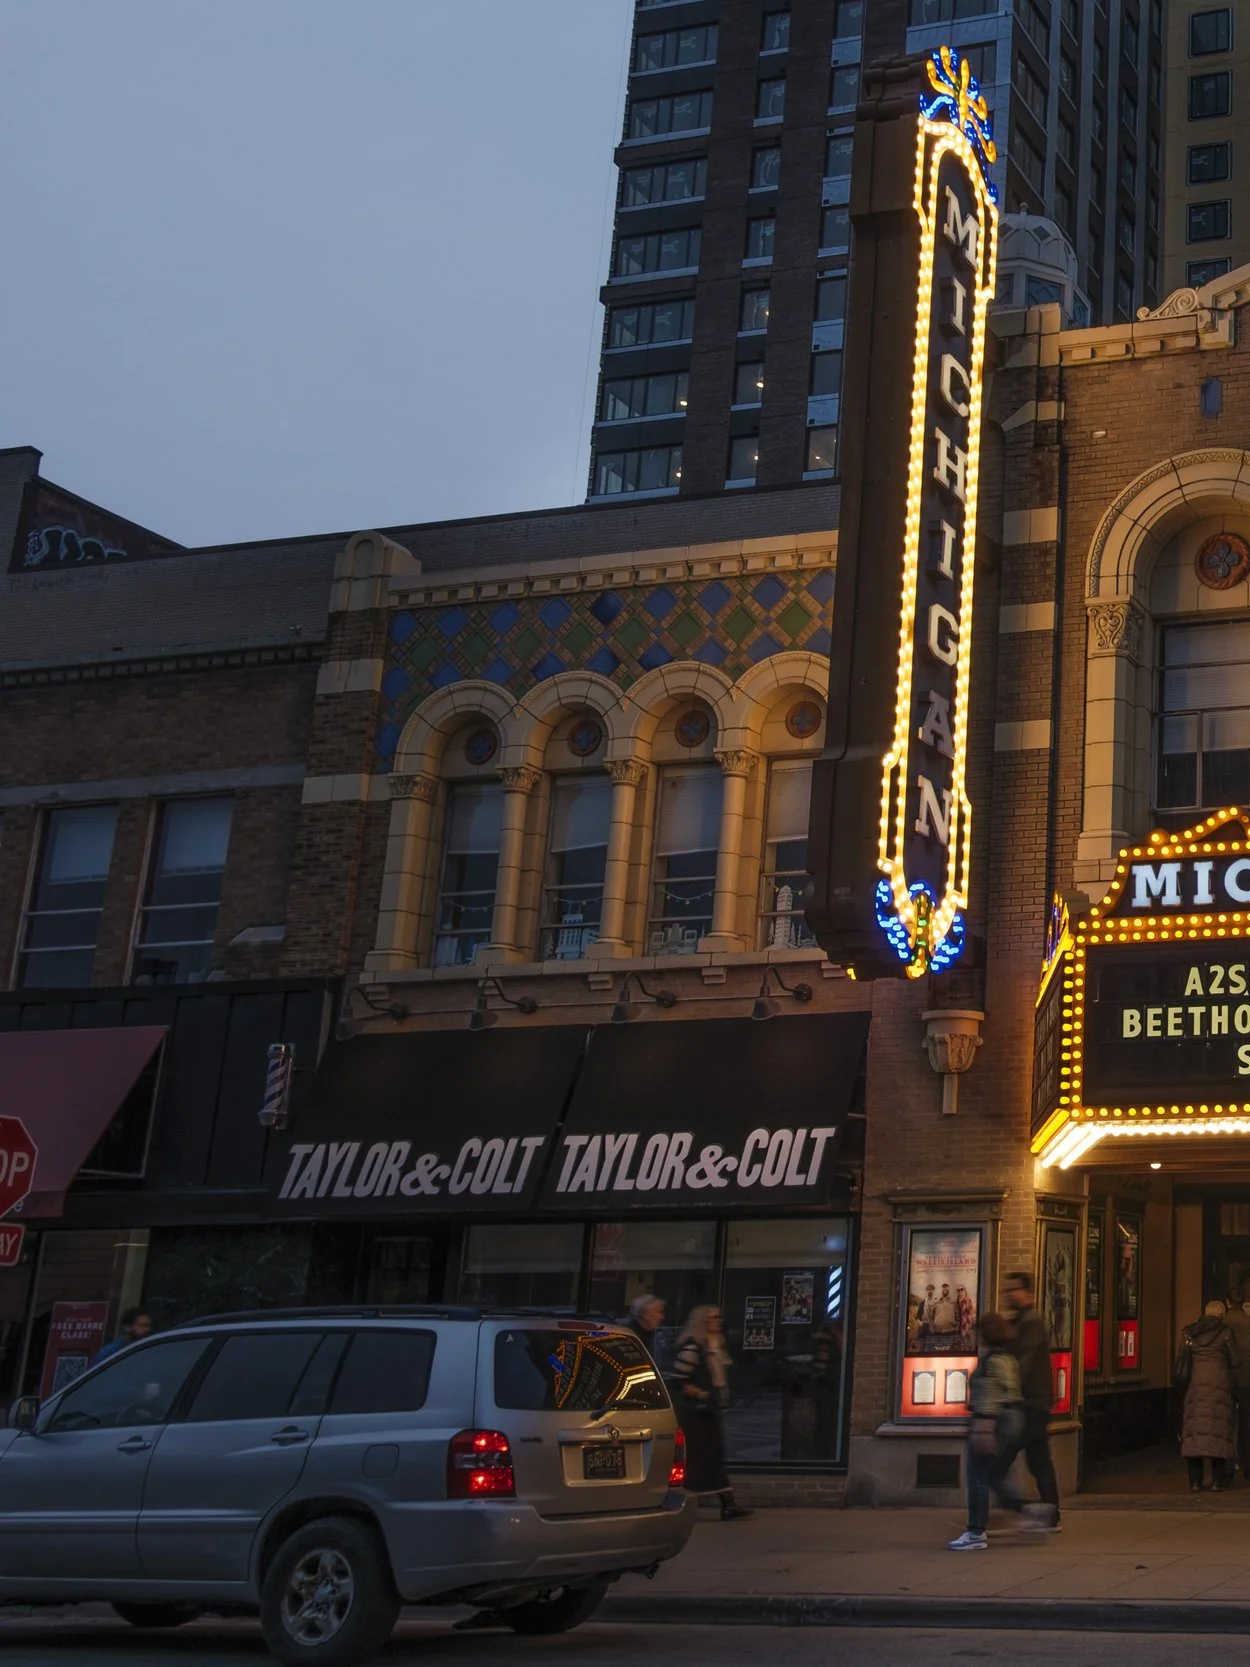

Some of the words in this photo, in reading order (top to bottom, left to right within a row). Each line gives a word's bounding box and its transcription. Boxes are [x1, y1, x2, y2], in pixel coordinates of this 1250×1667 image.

[914, 184, 981, 847] MICHIGAN
[278, 1135, 547, 1201] TAYLOR&COLT
[555, 1126, 836, 1194] TAYLOR&COLT
